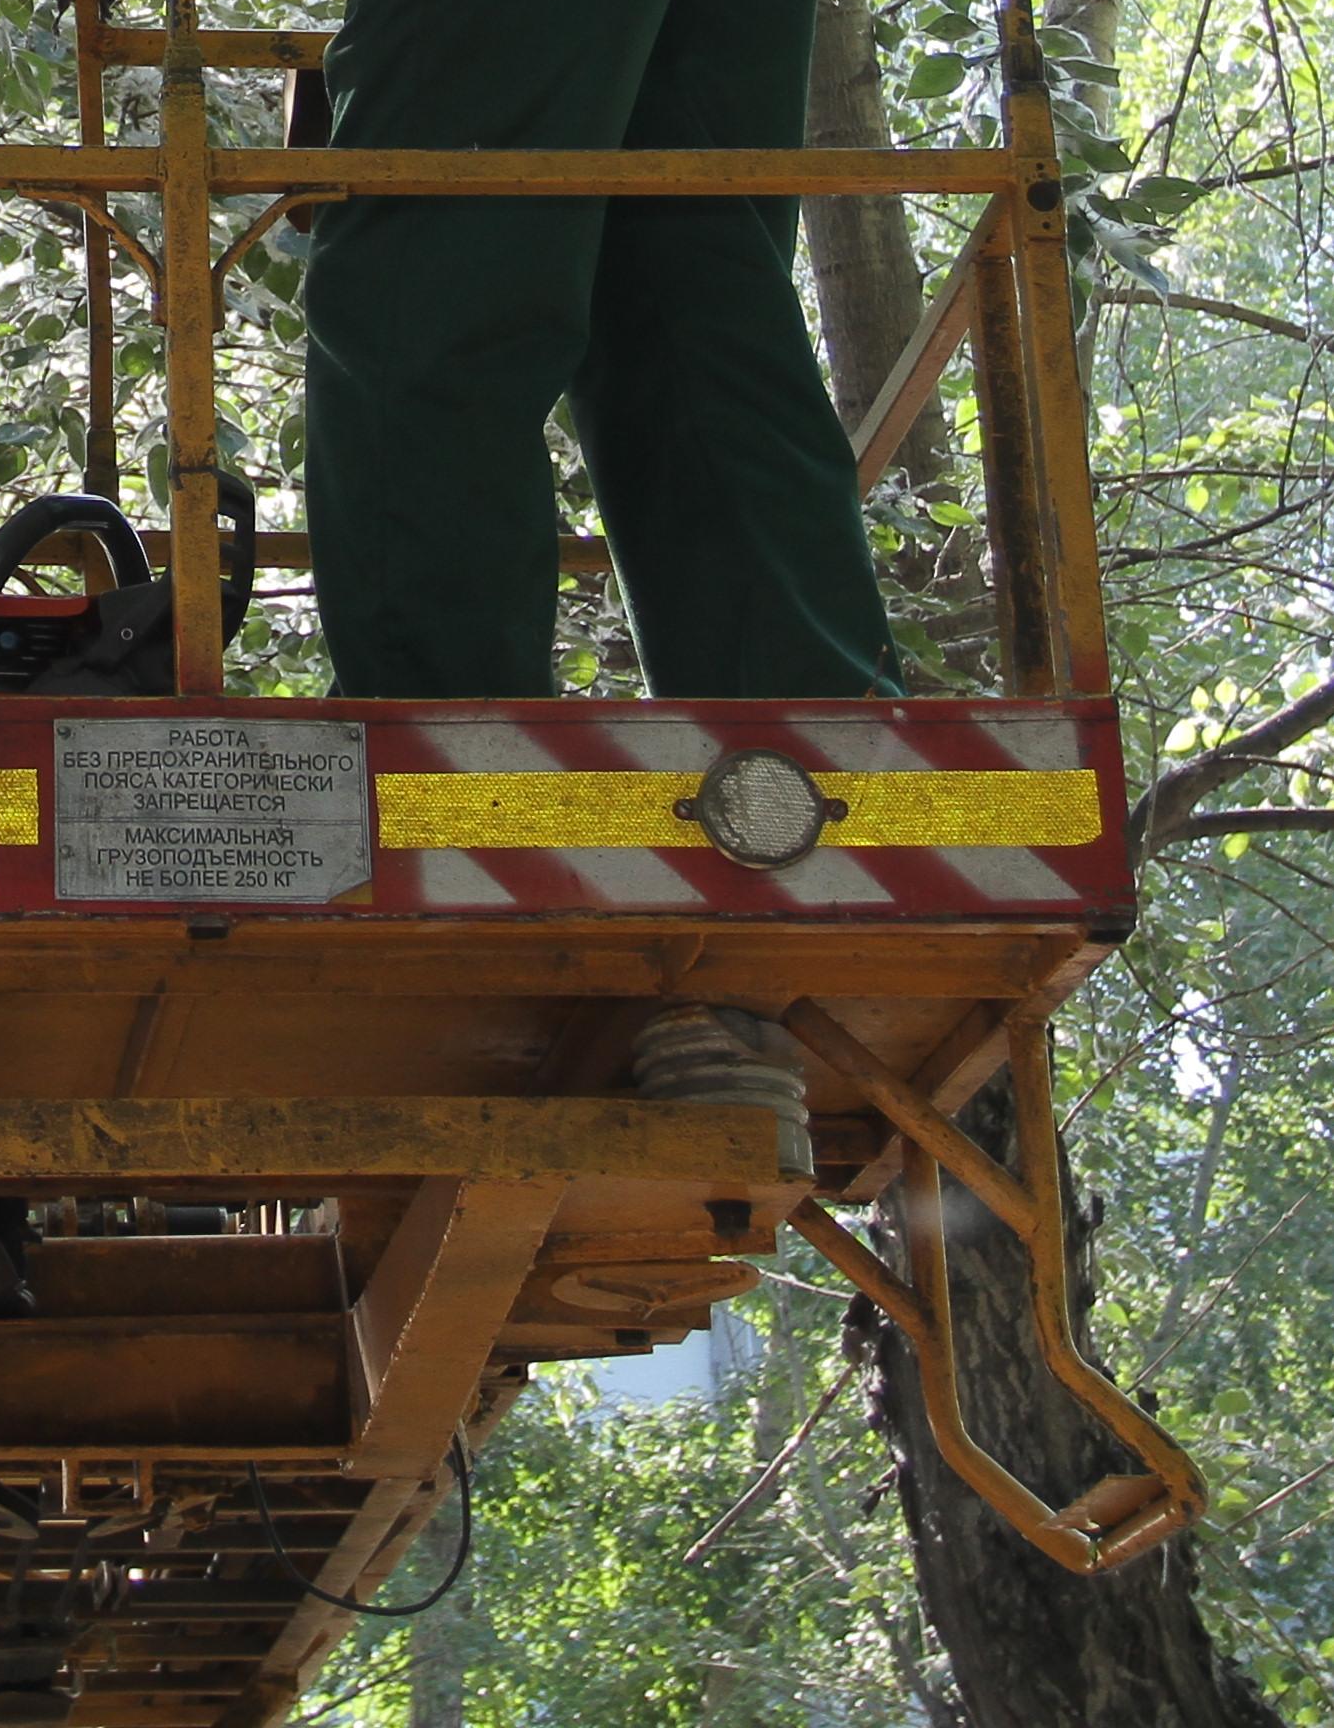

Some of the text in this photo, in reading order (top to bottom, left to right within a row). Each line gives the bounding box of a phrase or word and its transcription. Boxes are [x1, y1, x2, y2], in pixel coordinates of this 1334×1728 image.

[169, 729, 249, 747] РАБОТА
[63, 751, 354, 771] БЕЗ ПРЕДОХРАНИТЕЛЬНОГО
[84, 772, 333, 792] ПОЯСА КАТЕГОРИЧЕСКИ
[133, 793, 285, 814] ЗАПРЕЩАЕТСЯ
[125, 827, 294, 846] МАКСИМАЛЬНАЯ
[96, 848, 323, 868] ГРУЗОПОДЪЕМНОСТЬ
[126, 870, 296, 887] НЕ БОЛЕЕ 250 КГ
